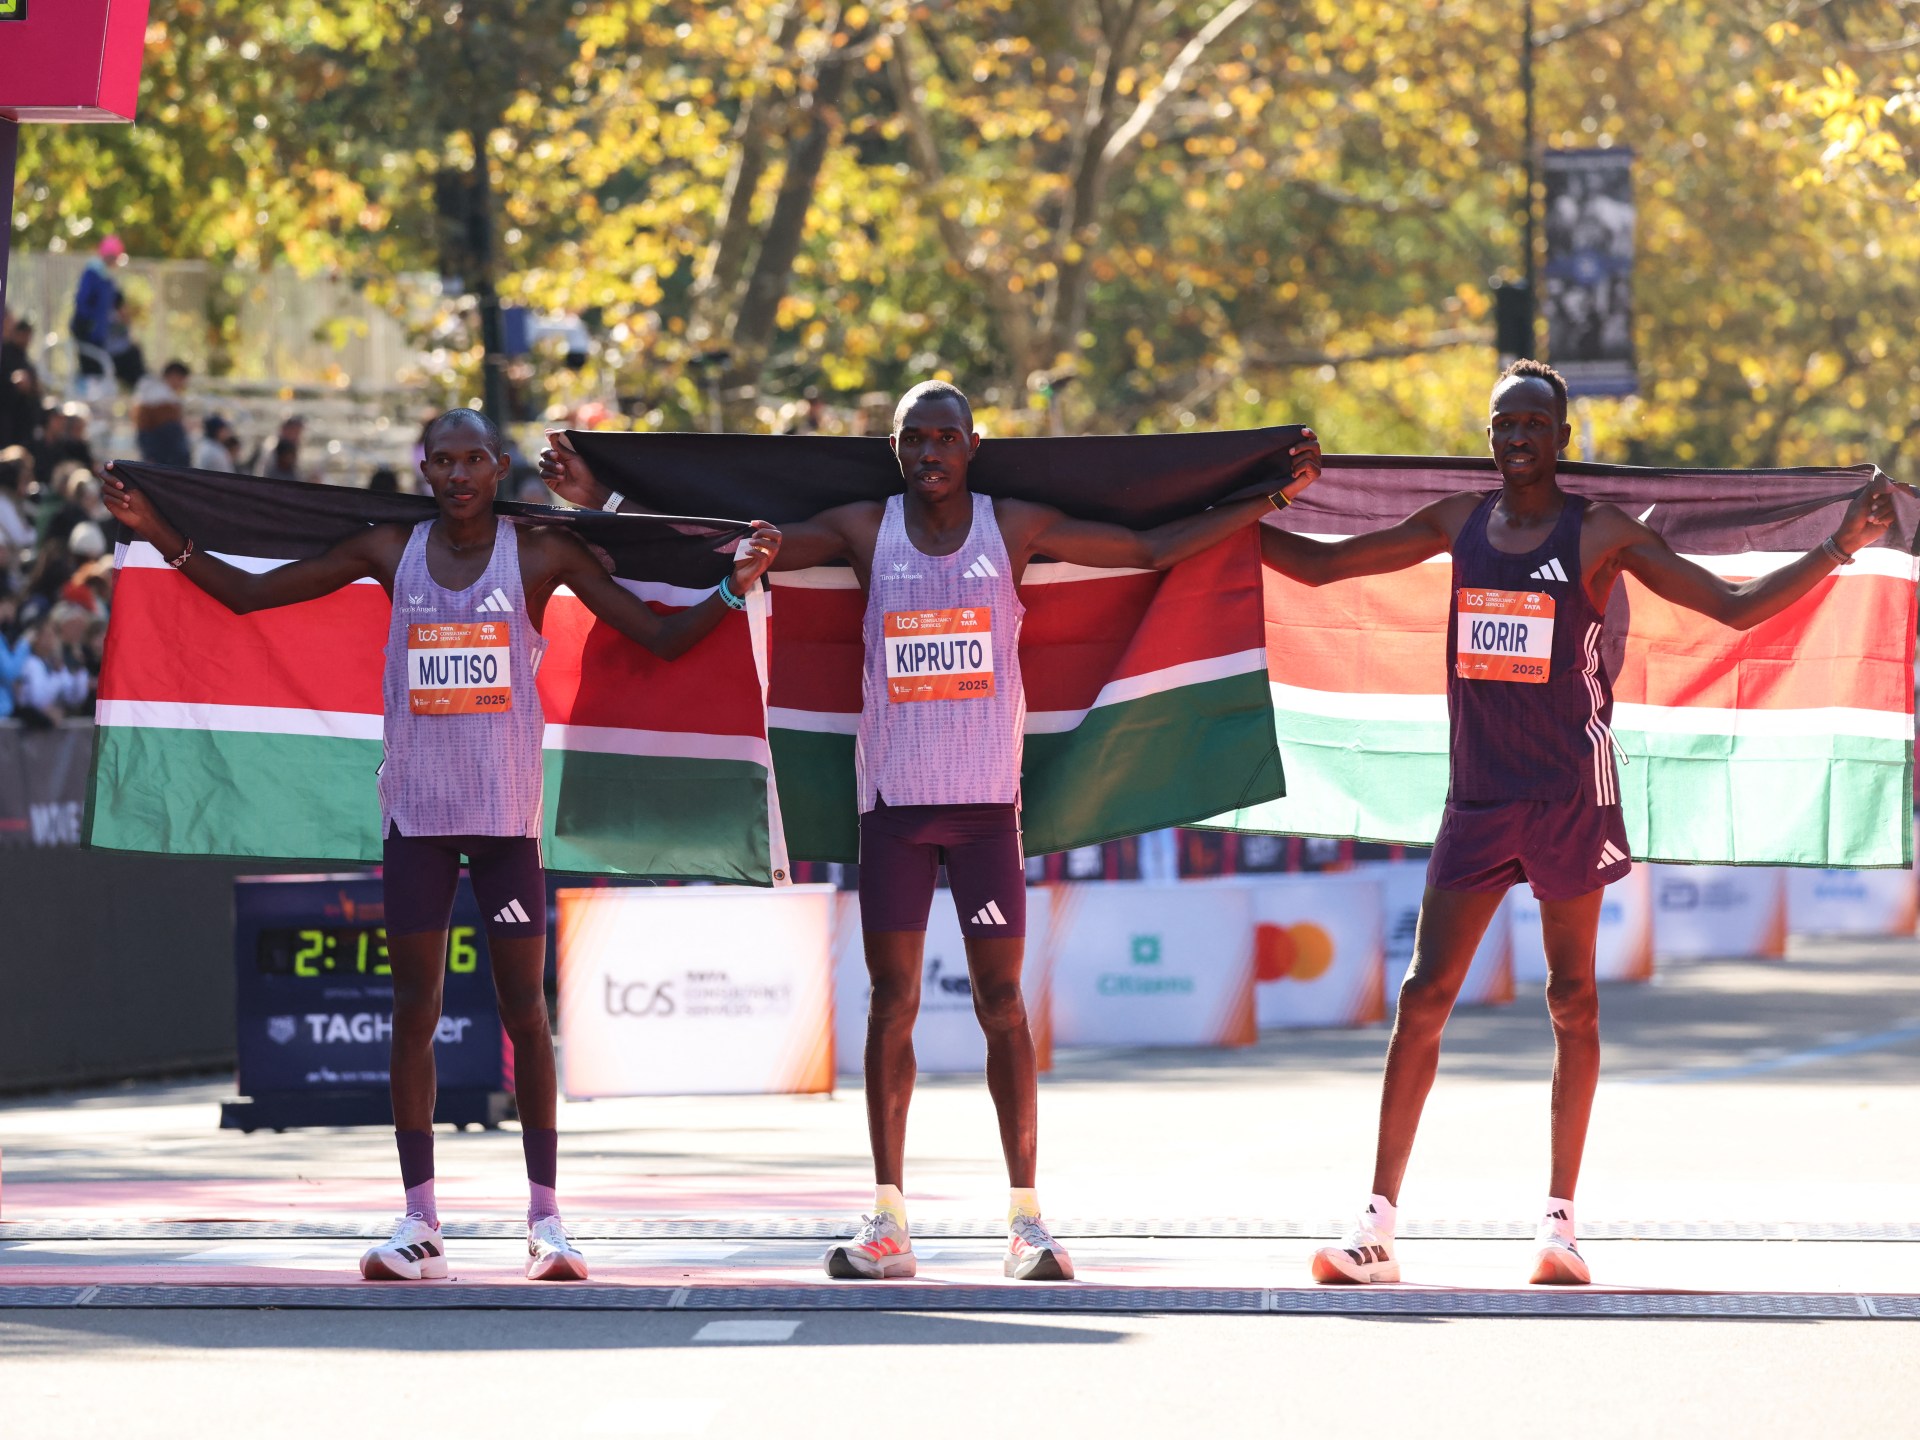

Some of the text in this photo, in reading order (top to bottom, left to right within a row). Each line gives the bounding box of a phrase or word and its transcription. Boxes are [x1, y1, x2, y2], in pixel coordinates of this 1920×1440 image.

[901, 572, 923, 580] Angels
[1466, 591, 1484, 606] tcs
[896, 615, 919, 630] tcs
[418, 627, 438, 642] tcs
[1471, 620, 1528, 653] KORIR
[896, 639, 983, 673] KIPRUTO
[419, 654, 498, 686] MUTISO
[1512, 663, 1543, 676] 2025
[958, 680, 989, 692] 2025
[475, 694, 506, 706] 2025
[604, 973, 676, 1018] tcs
